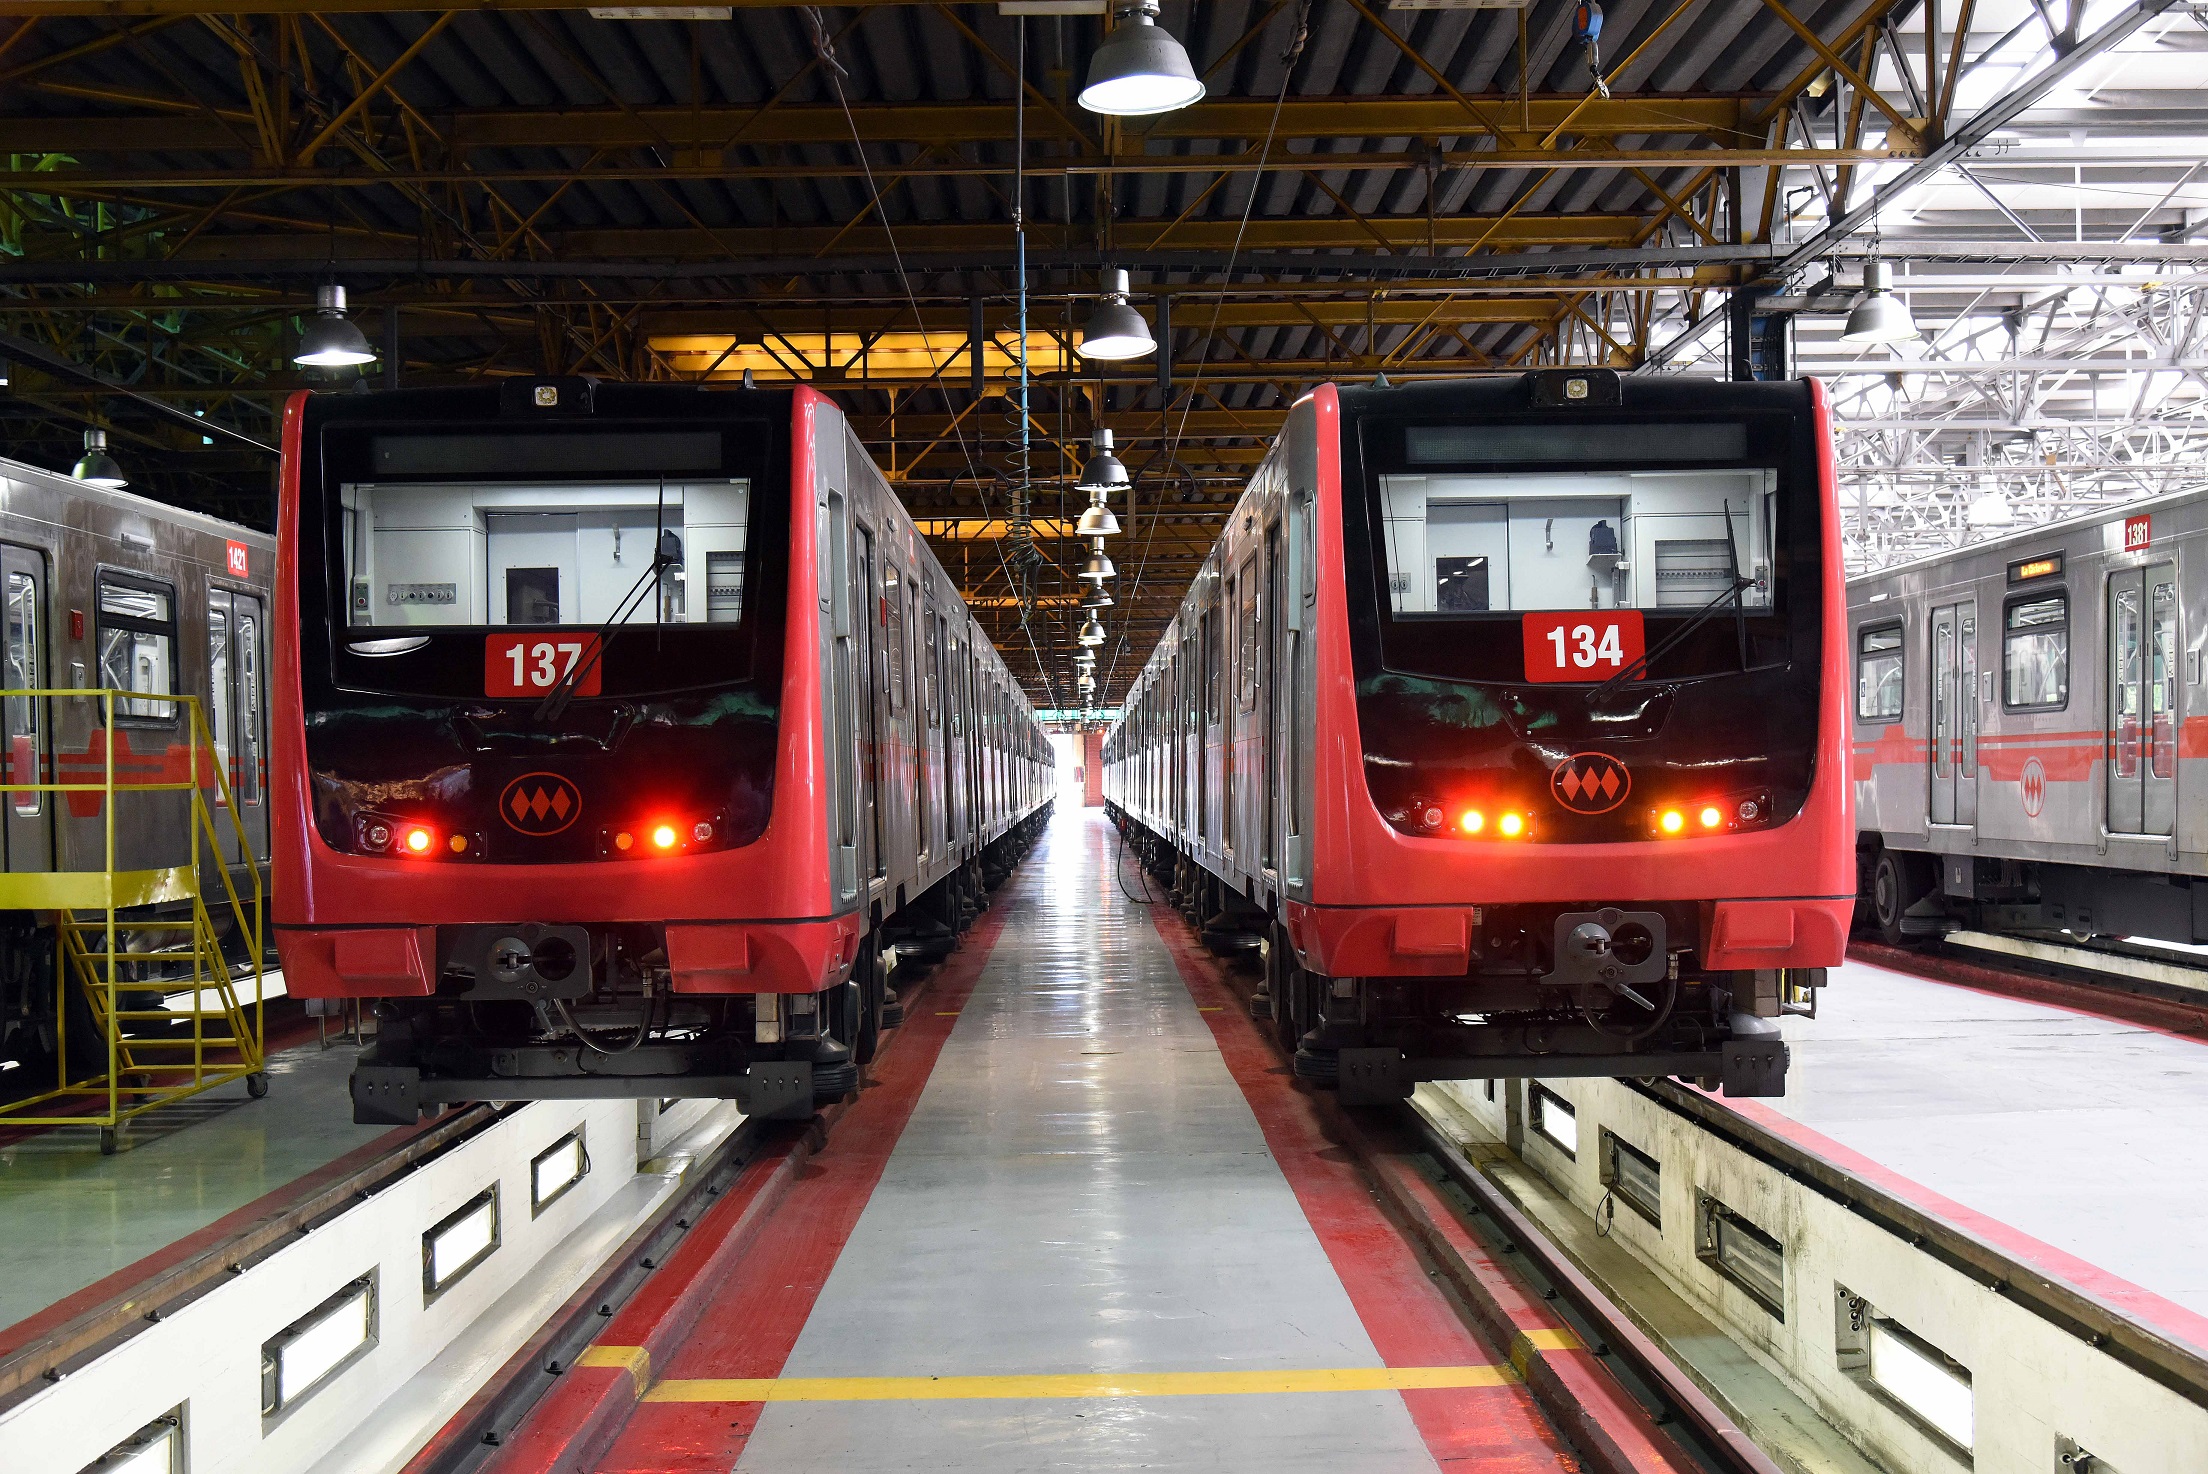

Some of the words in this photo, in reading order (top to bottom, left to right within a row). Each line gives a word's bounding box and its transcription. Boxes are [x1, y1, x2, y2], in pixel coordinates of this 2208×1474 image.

[2128, 522, 2148, 546] 1381
[229, 546, 246, 571] 1421
[1547, 624, 1624, 668] 134
[506, 642, 582, 687] 137
